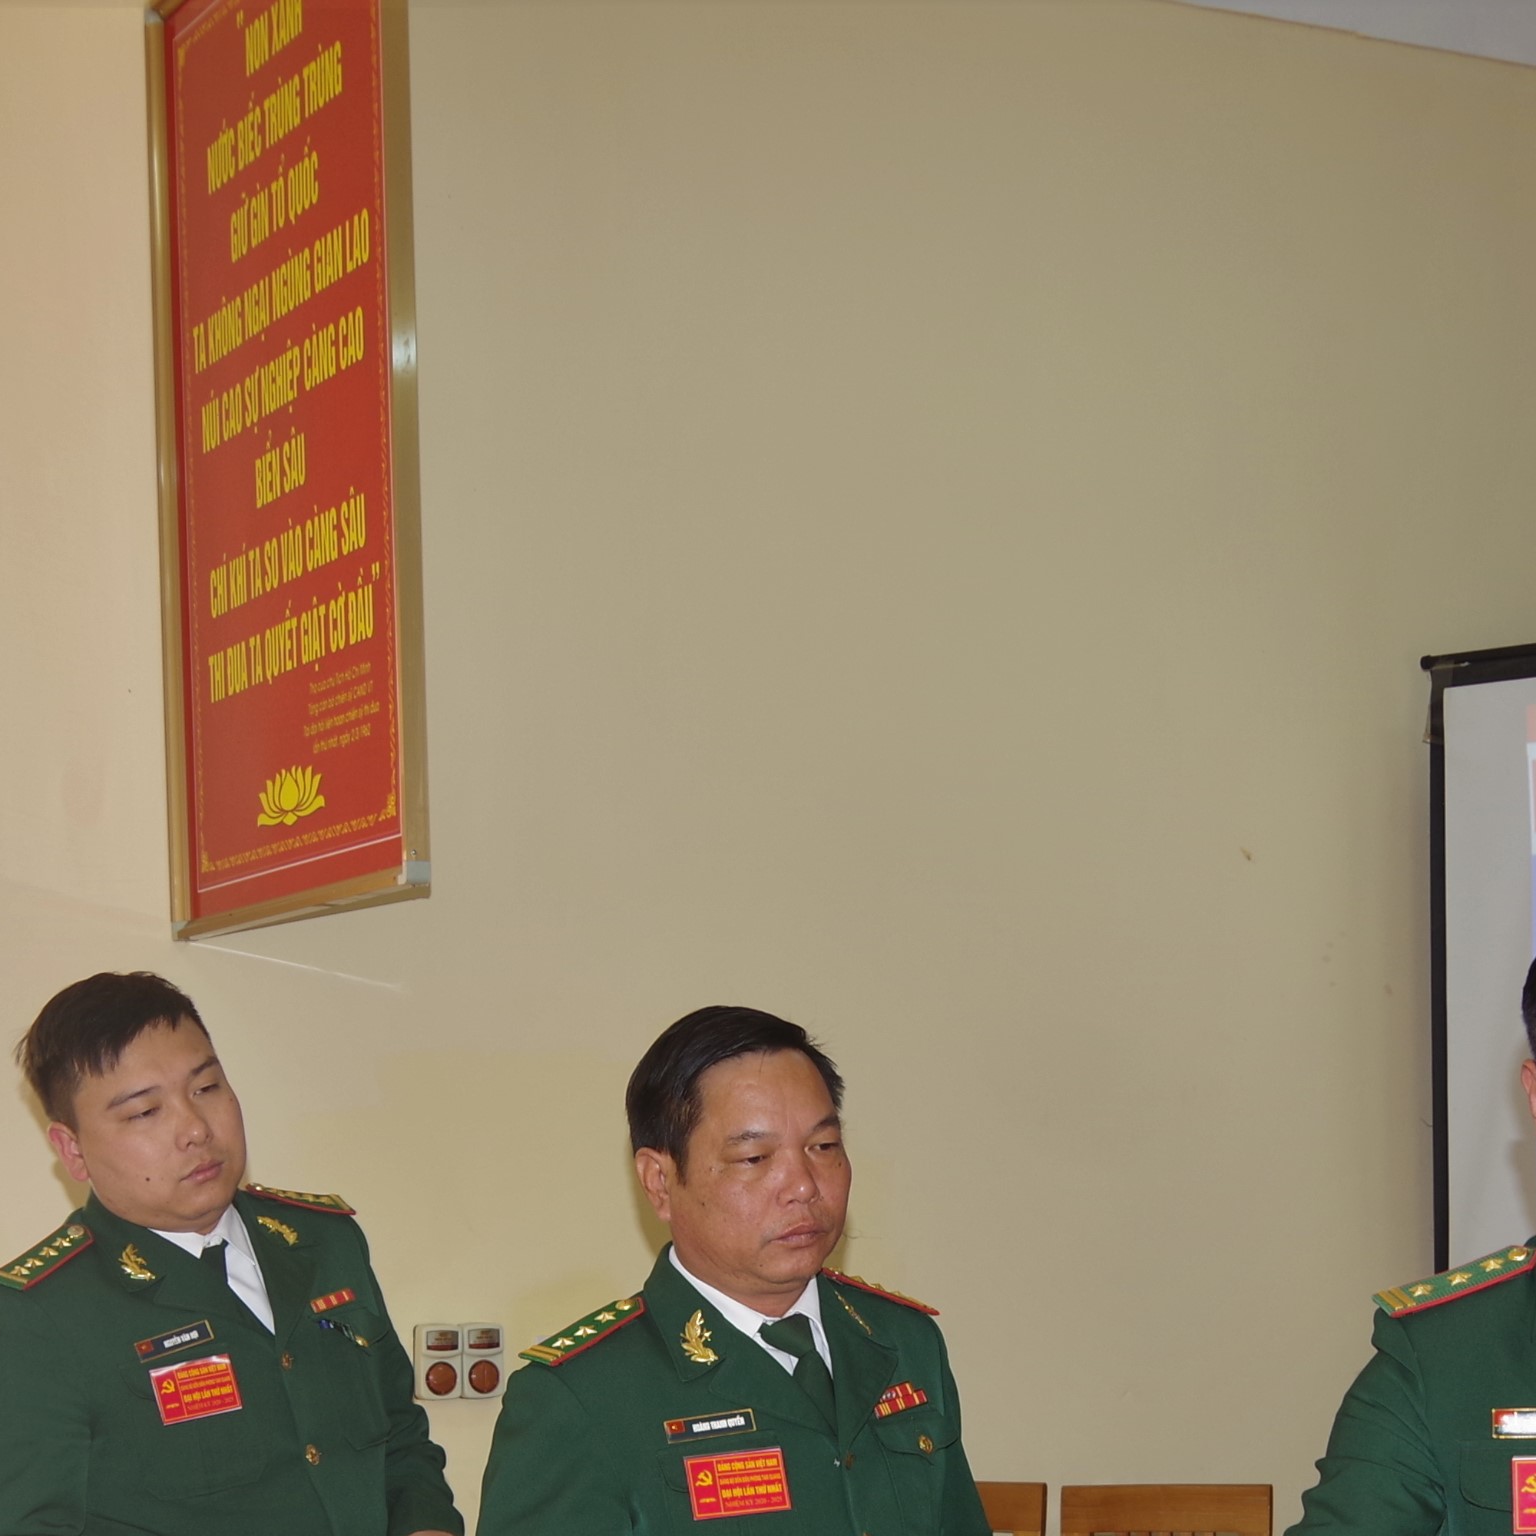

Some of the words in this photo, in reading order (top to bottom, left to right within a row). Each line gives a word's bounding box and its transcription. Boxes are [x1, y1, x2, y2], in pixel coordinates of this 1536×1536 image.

[207, 118, 235, 195] NƯỚC
[237, 91, 262, 172] BIẾC
[263, 75, 301, 149] TRÙNG
[302, 40, 342, 118] TRÙNG
[250, 182, 270, 248] GÌN
[270, 153, 285, 232] TỔ
[287, 135, 319, 224] QUỐC
[192, 322, 207, 374] TA
[207, 295, 243, 365] KHÔNG
[244, 275, 270, 341] NGẠI
[314, 225, 343, 294] GIAN
[345, 208, 369, 273] LAO
[202, 389, 221, 454] NÚI
[222, 383, 243, 442] CAO
[244, 365, 260, 434] SỰ
[260, 338, 300, 418] NGHIỆP
[303, 323, 337, 391] CÀNG
[338, 306, 365, 370] CAO
[283, 426, 306, 493] SÂU
[210, 552, 228, 618] CHÍ
[229, 543, 248, 610] KHÍ
[248, 547, 263, 600] TA
[264, 537, 279, 592] SO
[280, 518, 303, 583] VÀO
[305, 504, 339, 572] CÀNG
[340, 486, 366, 556] SÂU
[208, 651, 226, 703] THI
[227, 641, 248, 696] ĐUA
[249, 634, 264, 686] TA
[265, 600, 298, 684] QUYẾT
[300, 596, 326, 672] GIẬT
[329, 582, 346, 653] CỜ
